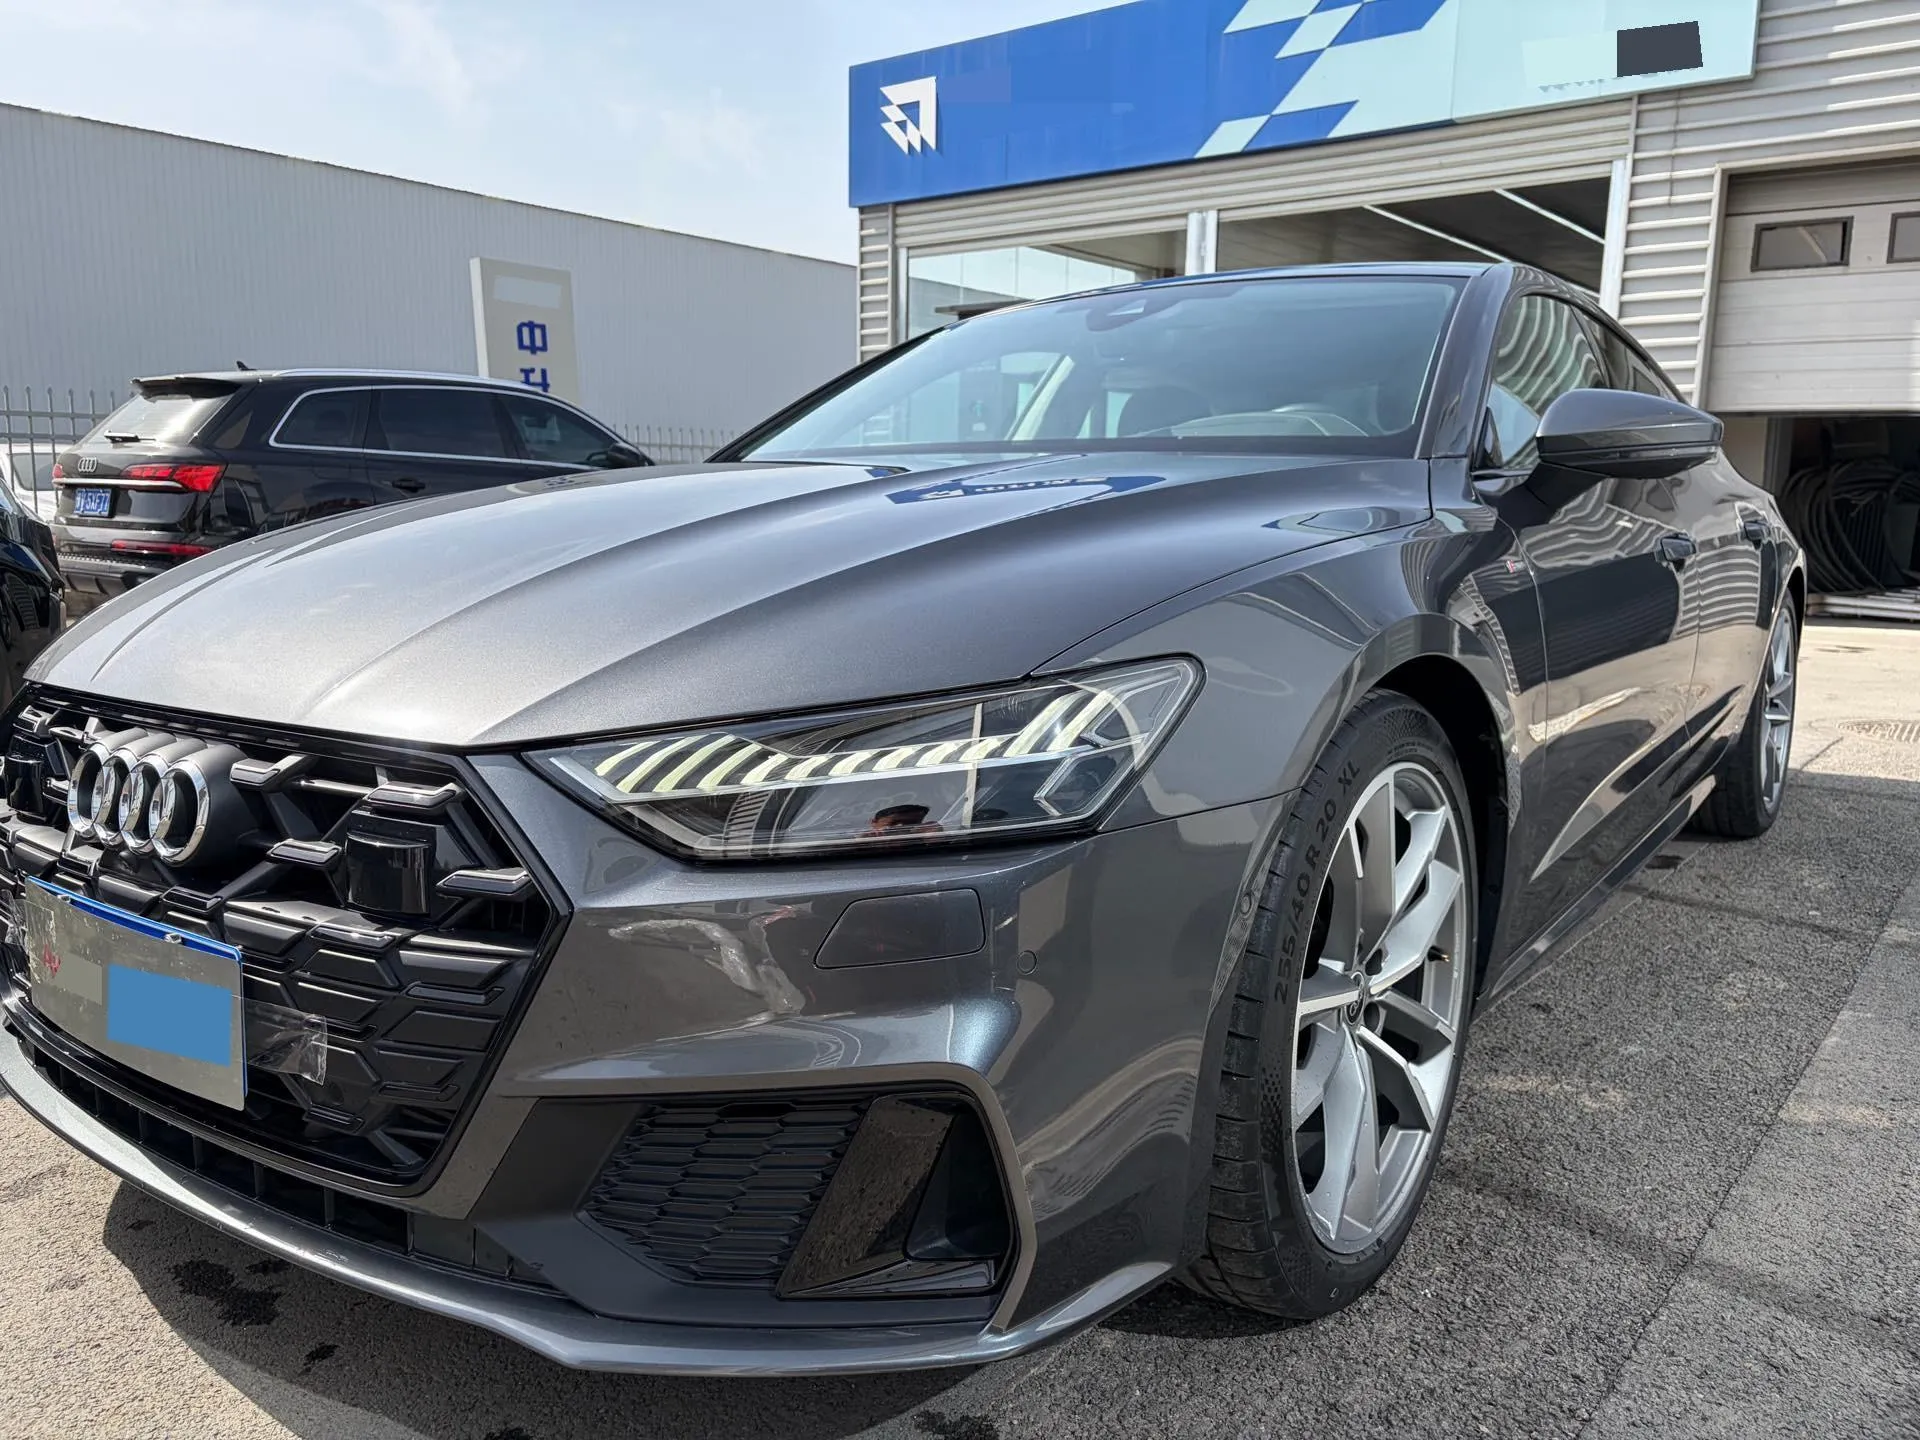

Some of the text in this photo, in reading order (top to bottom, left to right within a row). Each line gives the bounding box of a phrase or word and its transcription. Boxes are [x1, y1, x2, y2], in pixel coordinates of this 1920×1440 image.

[1274, 874, 1311, 1005] 255/40
[1305, 843, 1320, 866] R
[1315, 799, 1337, 840] 20
[1337, 760, 1360, 795] XL
